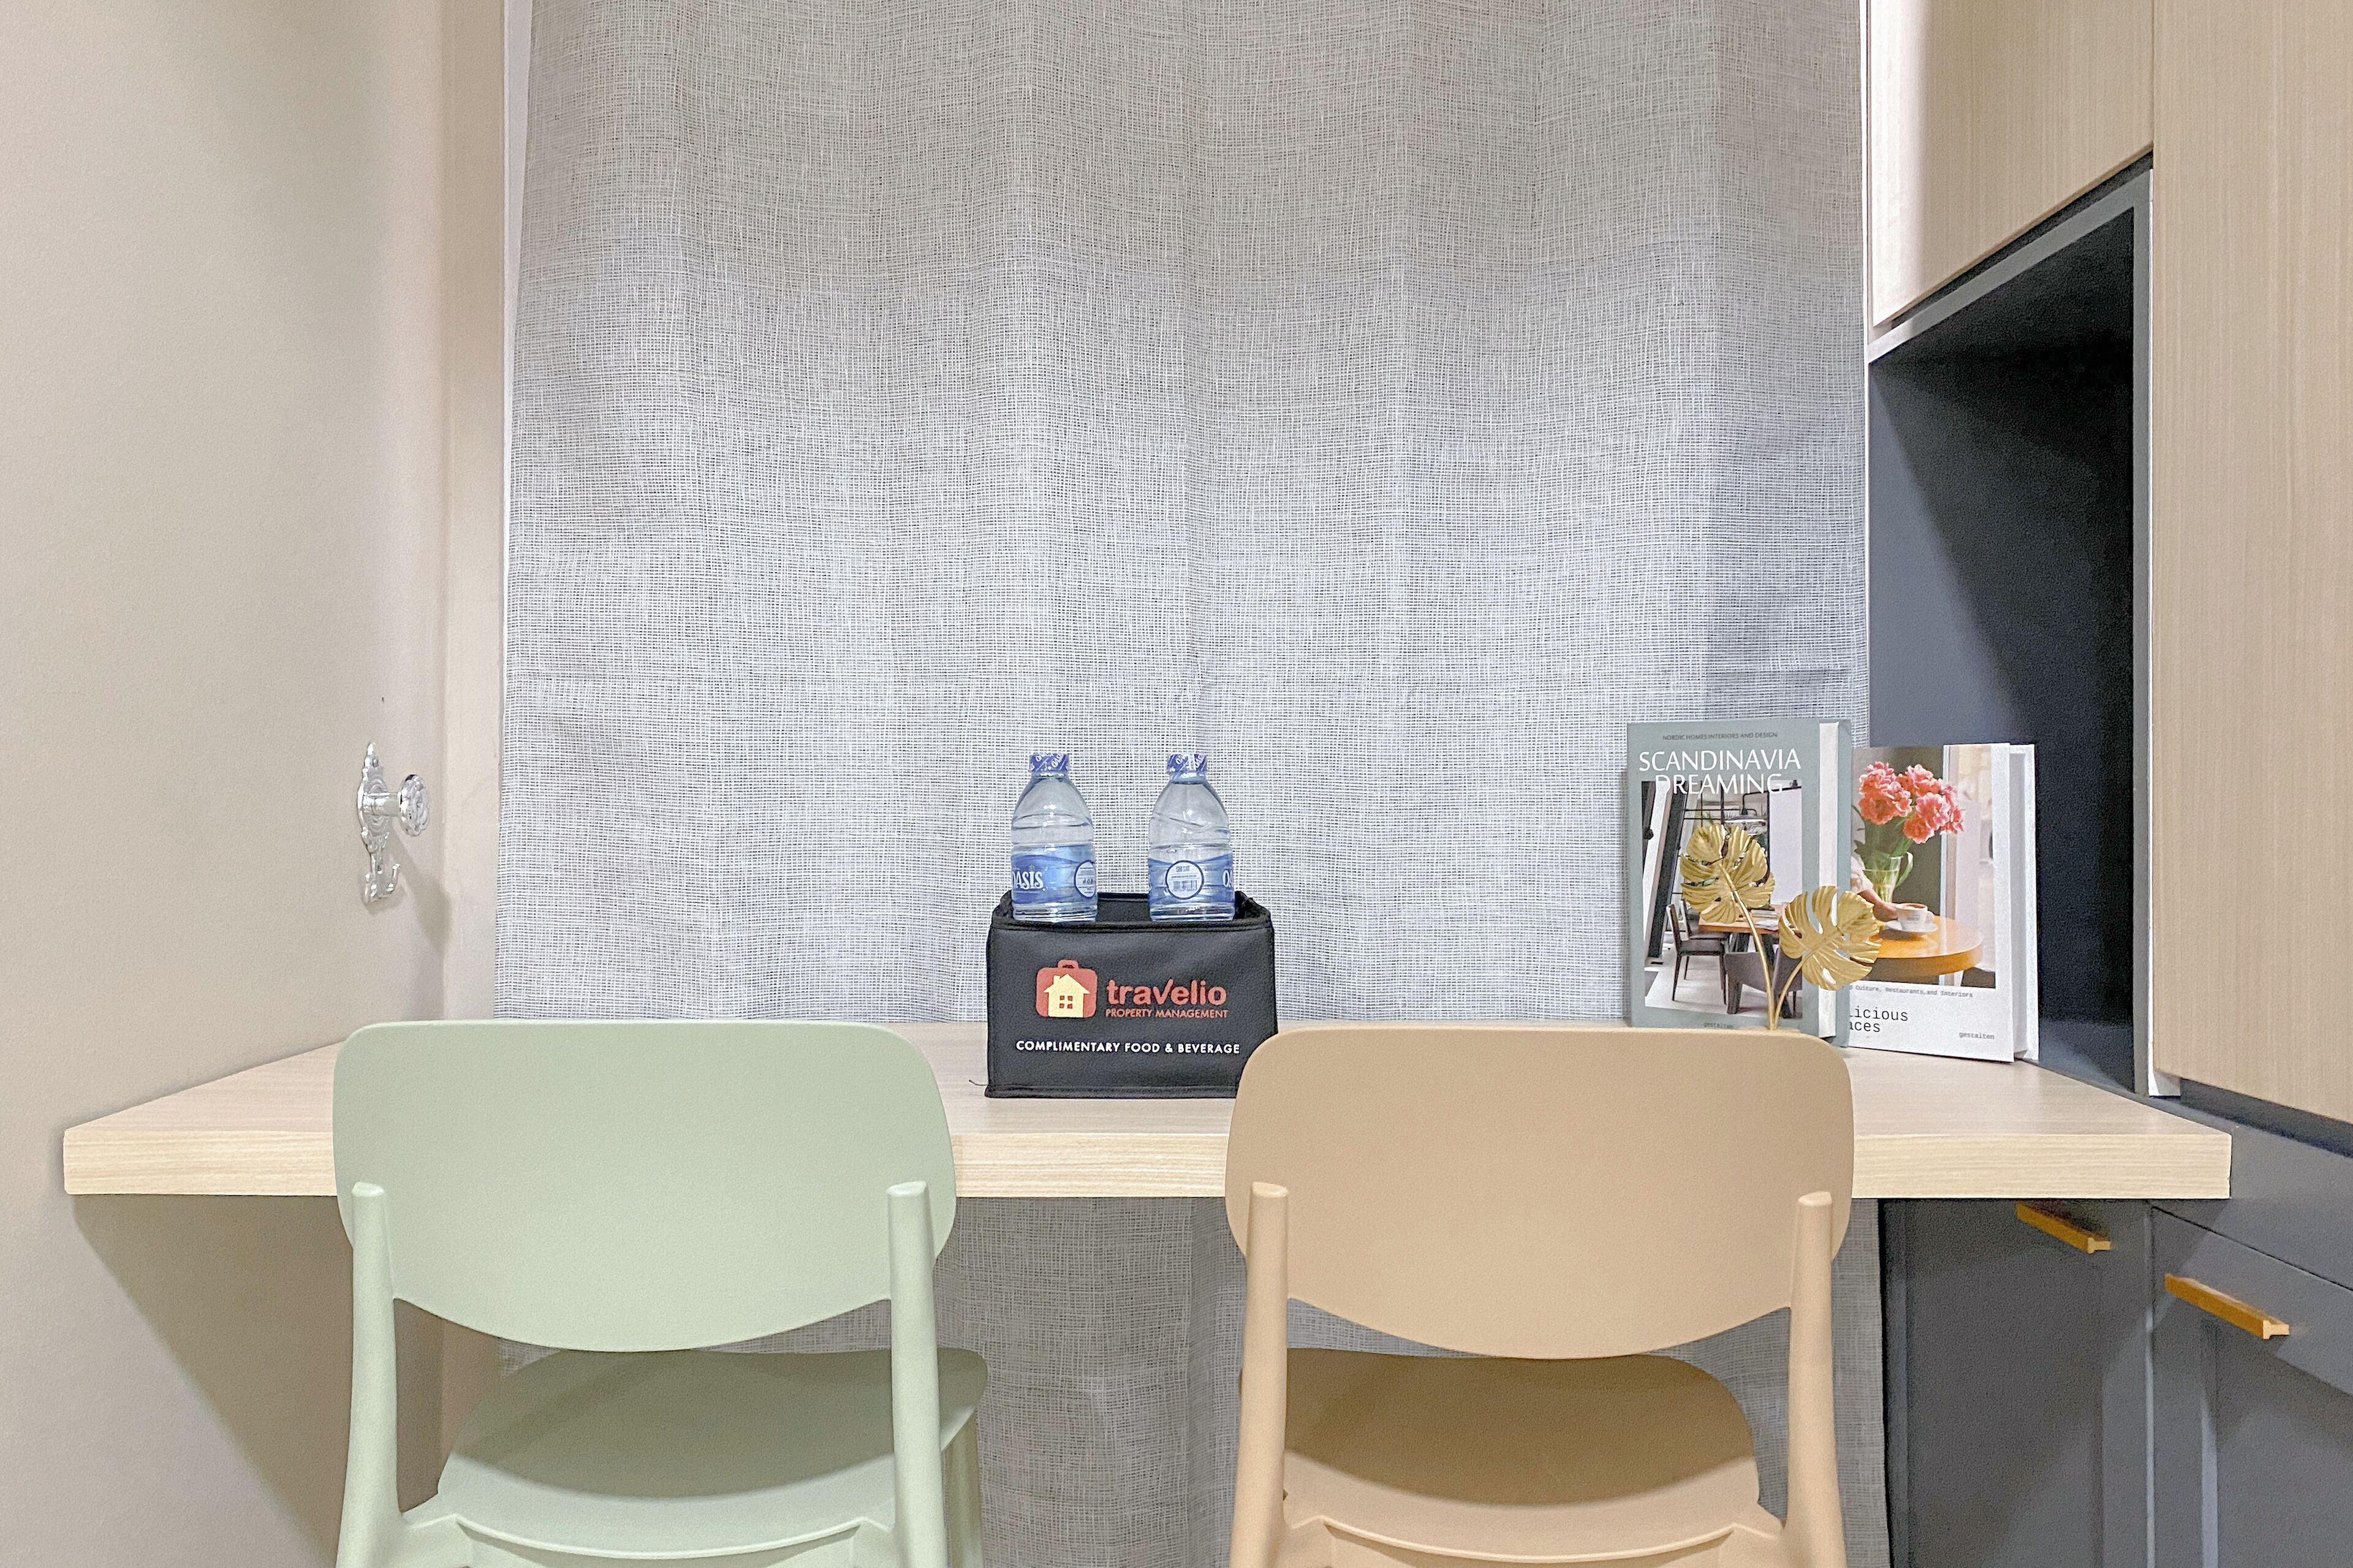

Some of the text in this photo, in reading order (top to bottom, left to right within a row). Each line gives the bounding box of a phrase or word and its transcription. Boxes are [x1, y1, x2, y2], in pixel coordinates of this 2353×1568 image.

[1639, 748, 1802, 772] SCANDINAVIA
[1654, 773, 1783, 795] DREAMING
[1106, 979, 1227, 1006] travelio
[1105, 1008, 1229, 1018] PROPERTY MANAGEMENT
[1015, 1040, 1240, 1055] COMPLIMENTARY FOOD & BEVERAGE
